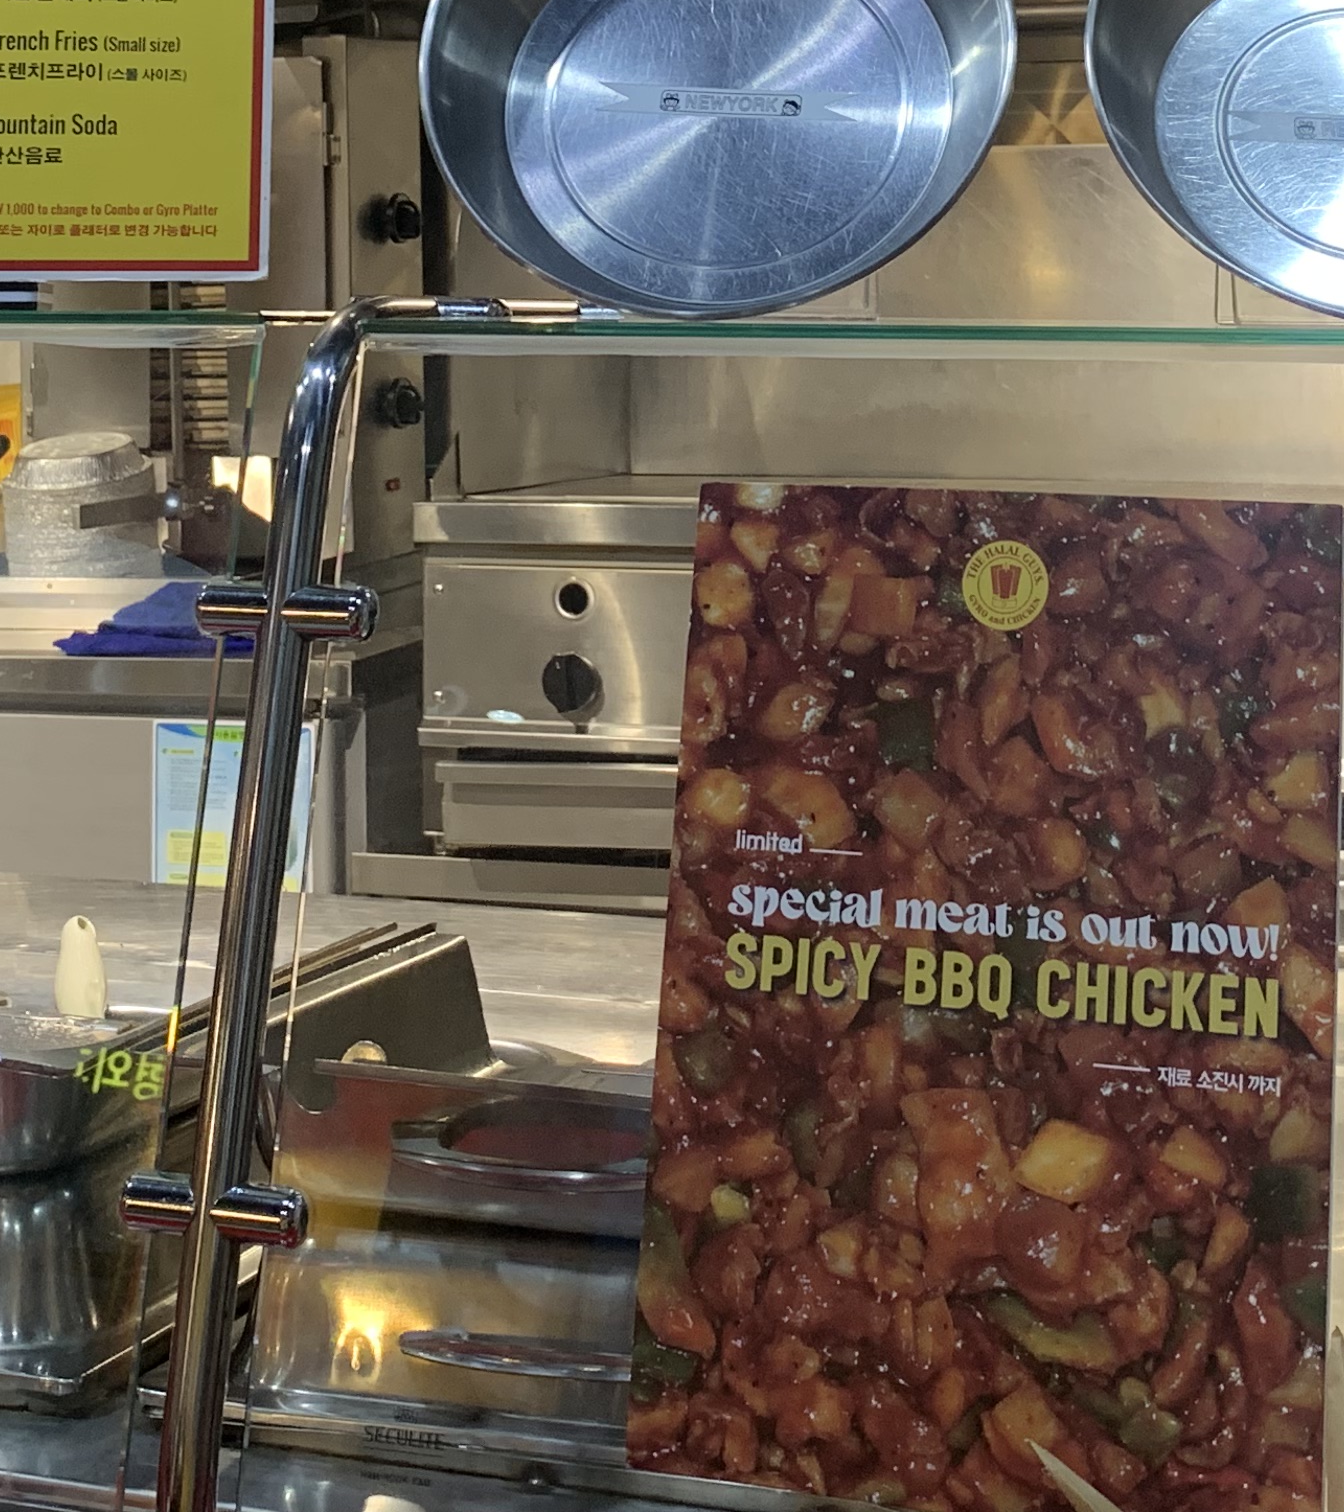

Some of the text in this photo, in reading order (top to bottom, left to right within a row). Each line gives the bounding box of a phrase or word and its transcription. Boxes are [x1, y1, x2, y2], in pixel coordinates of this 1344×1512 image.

[55, 30, 98, 52] Fries
[103, 35, 147, 53] (Small
[150, 36, 181, 54] size)
[141, 68, 188, 82] 사이즈)
[684, 93, 778, 113] NEWYORK
[72, 113, 118, 136] Soda
[6, 203, 35, 217] 1,000
[37, 204, 48, 216] to
[50, 204, 88, 218] change
[91, 204, 102, 216] to
[105, 203, 140, 216] Combo
[142, 205, 155, 216] or
[156, 203, 180, 218] Gyro
[182, 203, 218, 217] Platter
[27, 224, 65, 237] 자이로
[69, 224, 121, 237] 플래터로
[124, 224, 150, 236] 변경
[152, 224, 217, 237] 가능합니다
[967, 544, 1045, 586] THE HALAL GUYS
[736, 829, 804, 854] limited
[727, 883, 1280, 962] special meat is out now!
[724, 932, 1280, 1039] SPICY BBQ CHICKEN
[1157, 1066, 1282, 1097] 재료 소진시 까지
